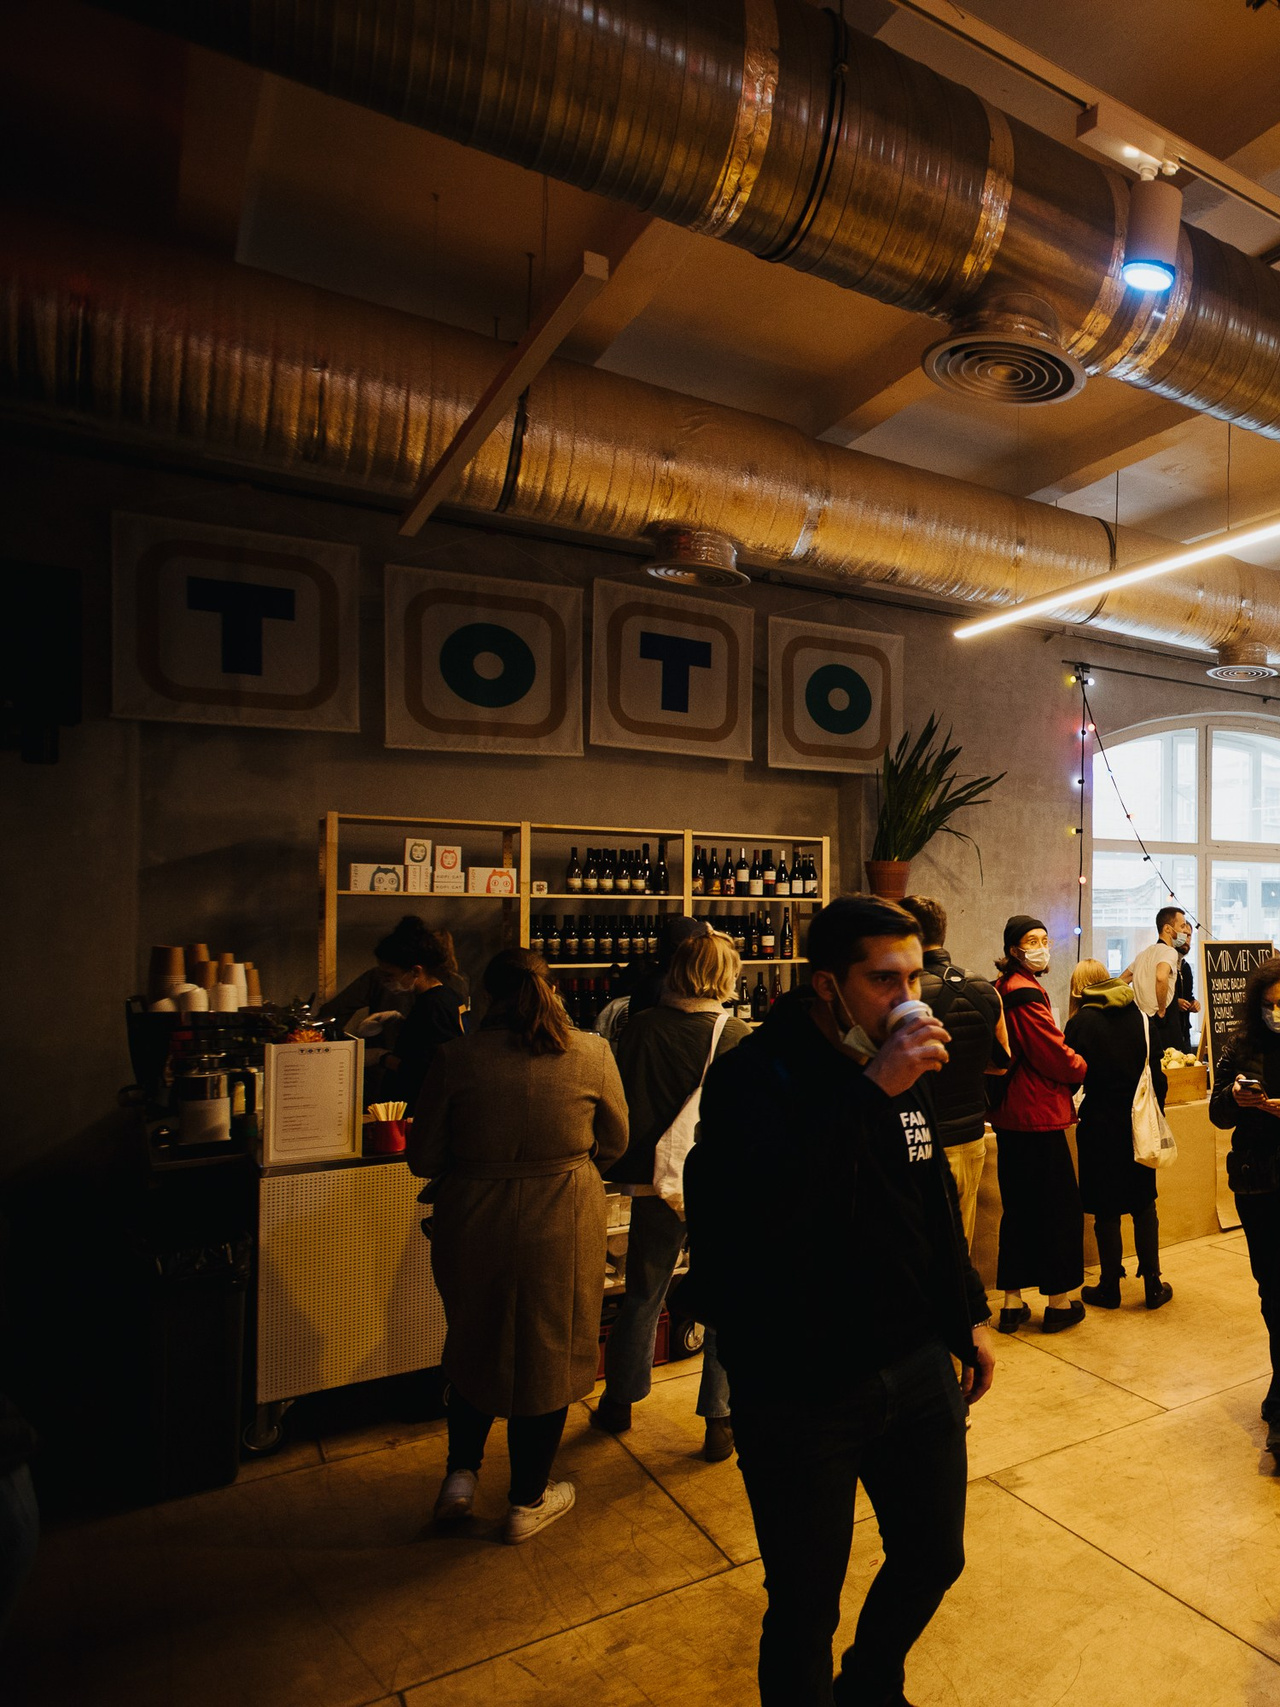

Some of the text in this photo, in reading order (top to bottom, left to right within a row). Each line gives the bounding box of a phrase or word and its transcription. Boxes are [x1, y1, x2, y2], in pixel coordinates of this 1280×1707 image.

[1211, 978, 1230, 991] ХУМУС
[1212, 992, 1231, 1005] ХУМУС
[1213, 1006, 1235, 1019] ХУМУС
[1214, 1021, 1226, 1034] СУП
[904, 1127, 932, 1145] FAM
[908, 1143, 933, 1163] FAM
